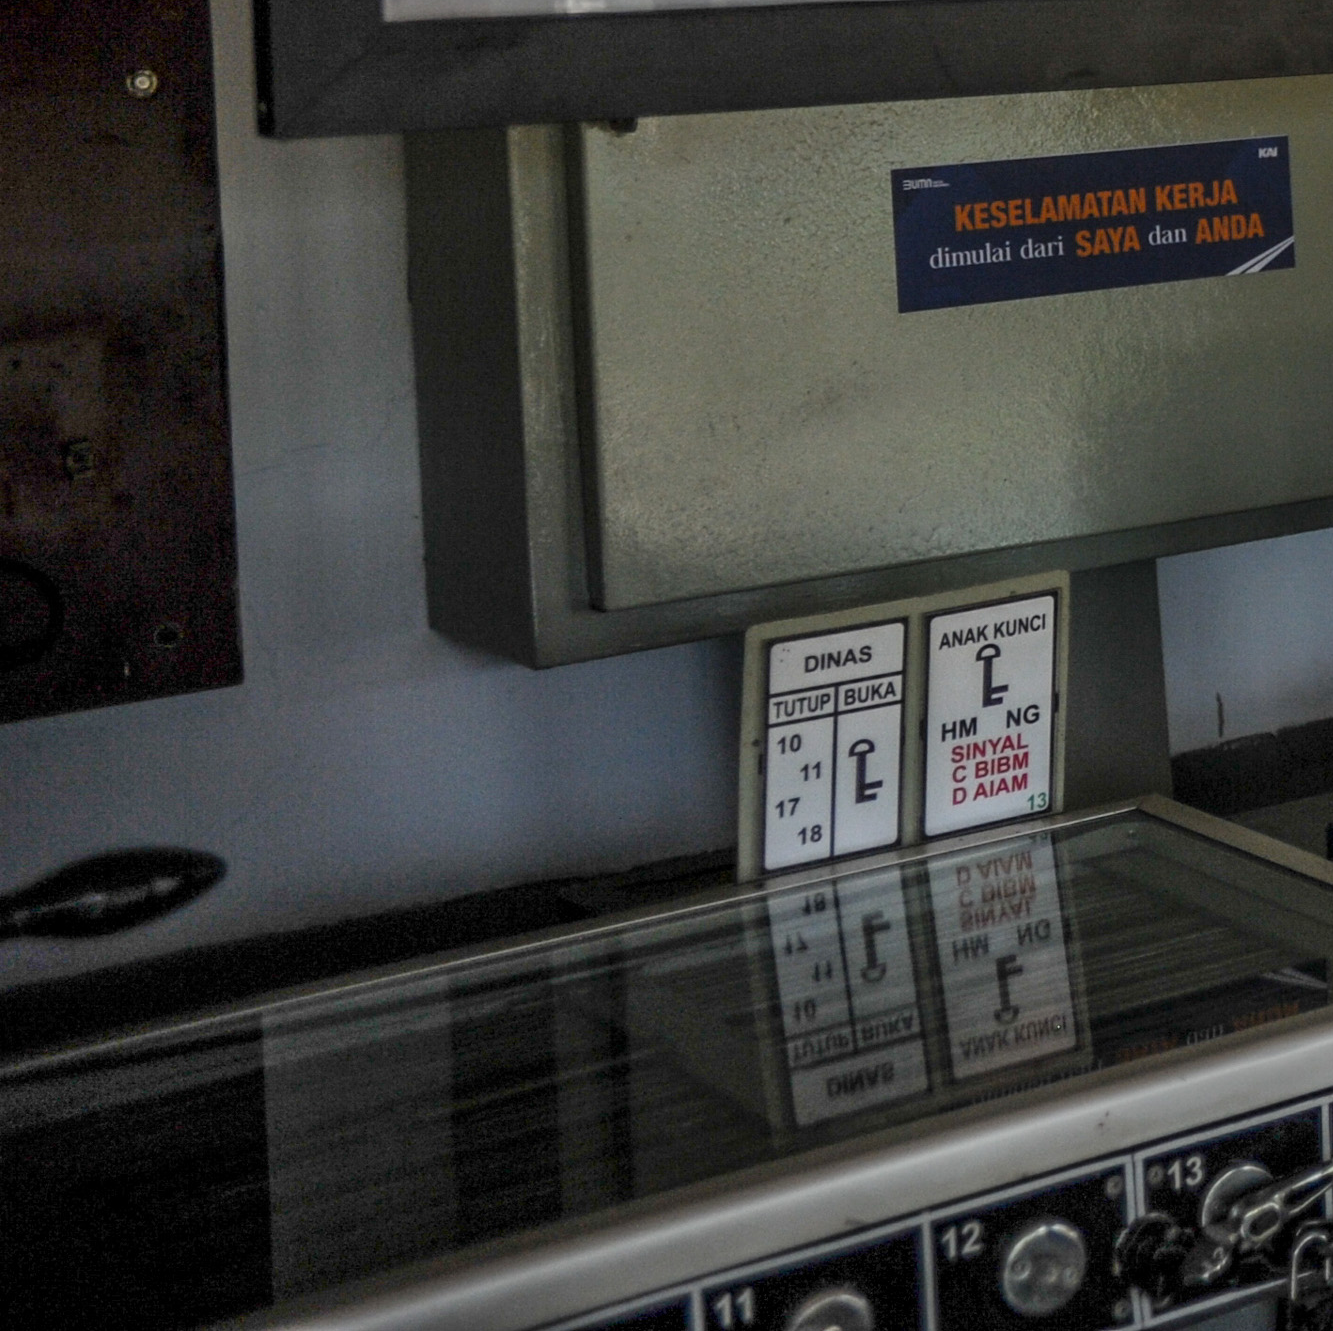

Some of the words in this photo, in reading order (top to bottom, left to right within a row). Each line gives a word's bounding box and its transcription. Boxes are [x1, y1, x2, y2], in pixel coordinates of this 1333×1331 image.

[954, 187, 1147, 232] KESELAMATAN
[1155, 179, 1238, 211] KERJA
[929, 241, 1011, 270] dimulai
[1020, 236, 1064, 260] dari
[1075, 227, 1141, 258] SAYA
[1148, 225, 1187, 246] dan
[1195, 212, 1264, 244] ANDA
[939, 626, 989, 650] ANAK
[994, 613, 1046, 639] KUNCI
[804, 645, 873, 673] DINAS
[773, 692, 831, 720] TUTUP
[844, 681, 897, 706] BUKA
[941, 717, 978, 742] HM
[1006, 704, 1040, 729] NG
[777, 734, 802, 755] 10
[951, 732, 1029, 764] SINYAL
[799, 761, 822, 781] 11
[952, 765, 966, 783] C
[975, 751, 1029, 779] BIBM
[952, 787, 967, 805] D
[972, 773, 1029, 802] AIAM
[1026, 792, 1047, 811] 13
[775, 797, 800, 819] 17
[797, 824, 823, 846] 18
[1167, 1157, 1203, 1191] 13
[940, 1221, 984, 1259] 12
[714, 1289, 755, 1328] 11
